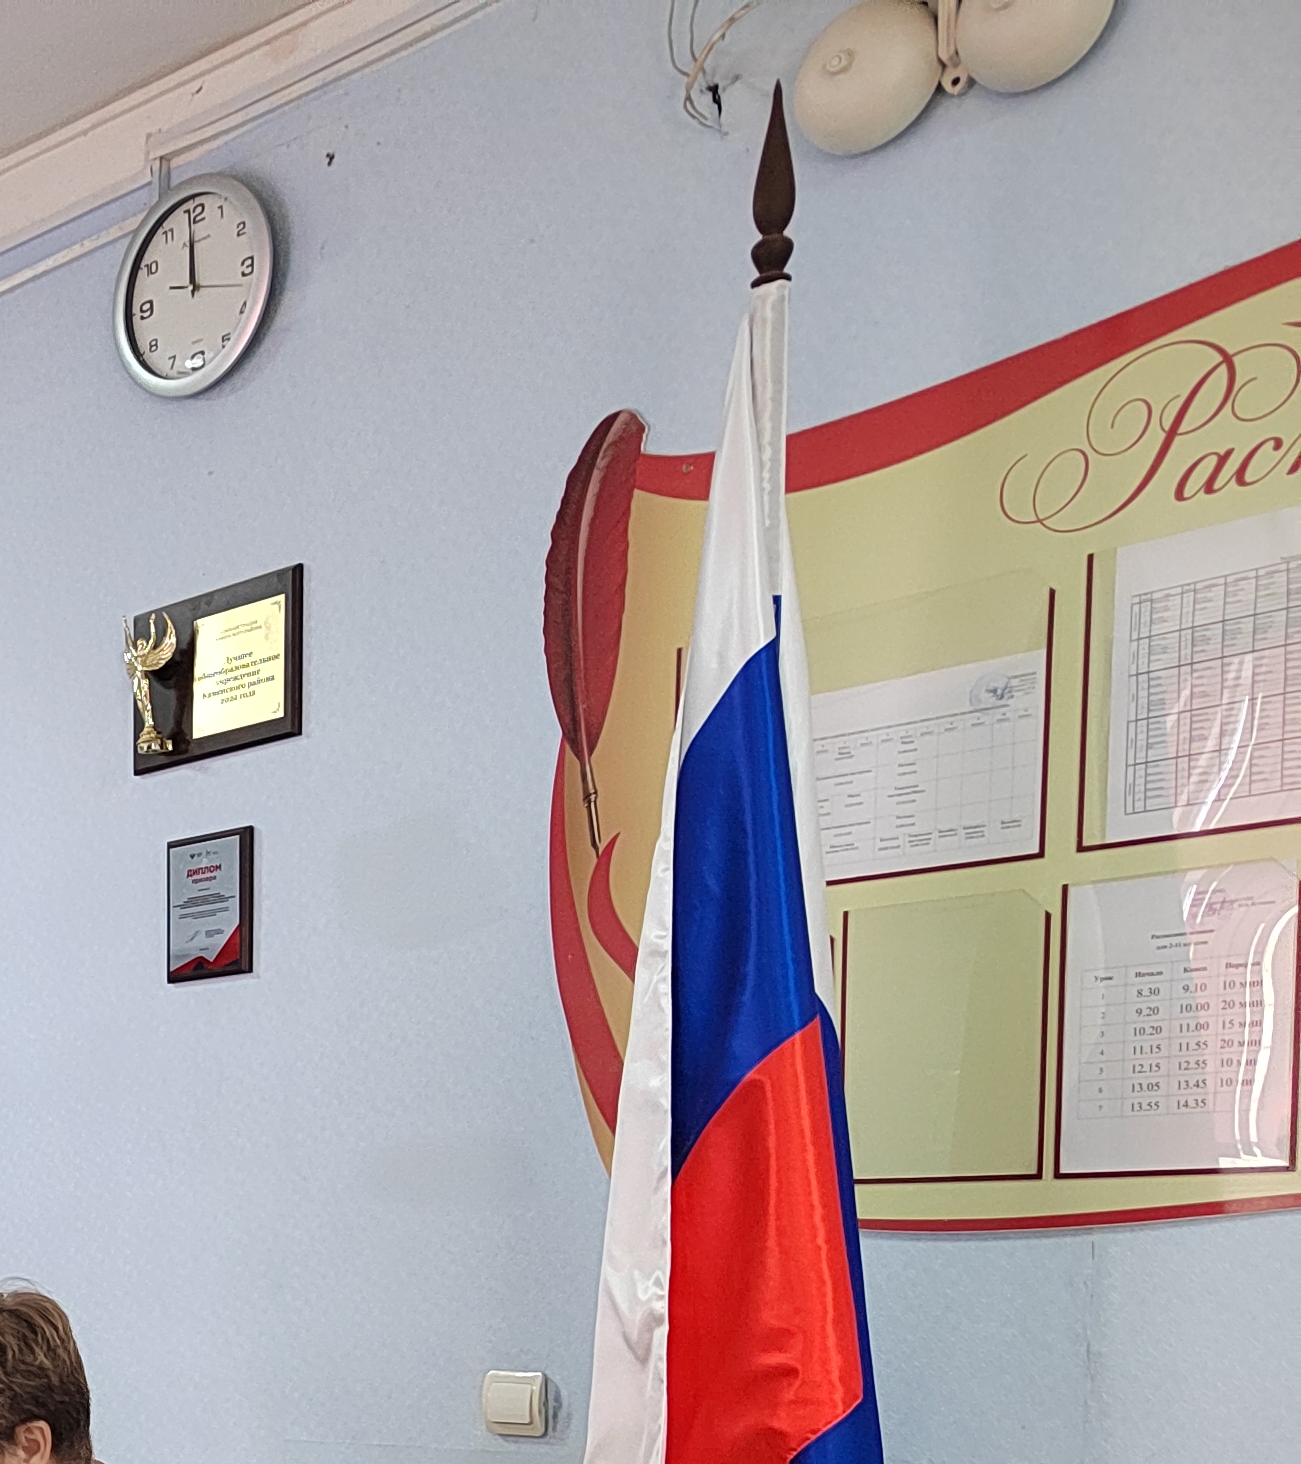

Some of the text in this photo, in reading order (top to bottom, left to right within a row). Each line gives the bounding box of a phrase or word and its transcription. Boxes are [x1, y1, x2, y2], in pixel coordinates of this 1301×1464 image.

[217, 204, 225, 219] 1
[162, 227, 174, 244] 11
[236, 221, 246, 237] 2
[144, 260, 159, 277] 10
[240, 255, 255, 277] 3
[139, 299, 154, 321] 9
[148, 338, 158, 353] 8
[168, 355, 177, 370] 7
[1000, 338, 1301, 534] Рас
[186, 863, 222, 879] ДИПЛОМ
[1136, 987, 1160, 999] 8.30
[1182, 983, 1207, 994] 9.10
[1223, 980, 1236, 990] 10
[1135, 1006, 1159, 1018] 9.20
[1179, 1001, 1210, 1014] 10.00
[1221, 1000, 1235, 1010] 20
[1132, 1025, 1162, 1037] 10.20
[1179, 1021, 1209, 1033] 11.00
[1222, 1019, 1234, 1030] 15
[1132, 1044, 1162, 1056] 11.15
[1178, 1040, 1208, 1052] 11.55
[1219, 1038, 1234, 1049] 20
[1132, 1062, 1161, 1074] 12.15
[1177, 1059, 1208, 1071] 12.55
[1220, 1058, 1233, 1068] 10
[1131, 1082, 1160, 1093] 13.05
[1177, 1078, 1207, 1090] 13.45
[1220, 1077, 1233, 1087] 10
[1131, 1100, 1160, 1112] 13.55
[1176, 1098, 1207, 1110] 14.35
